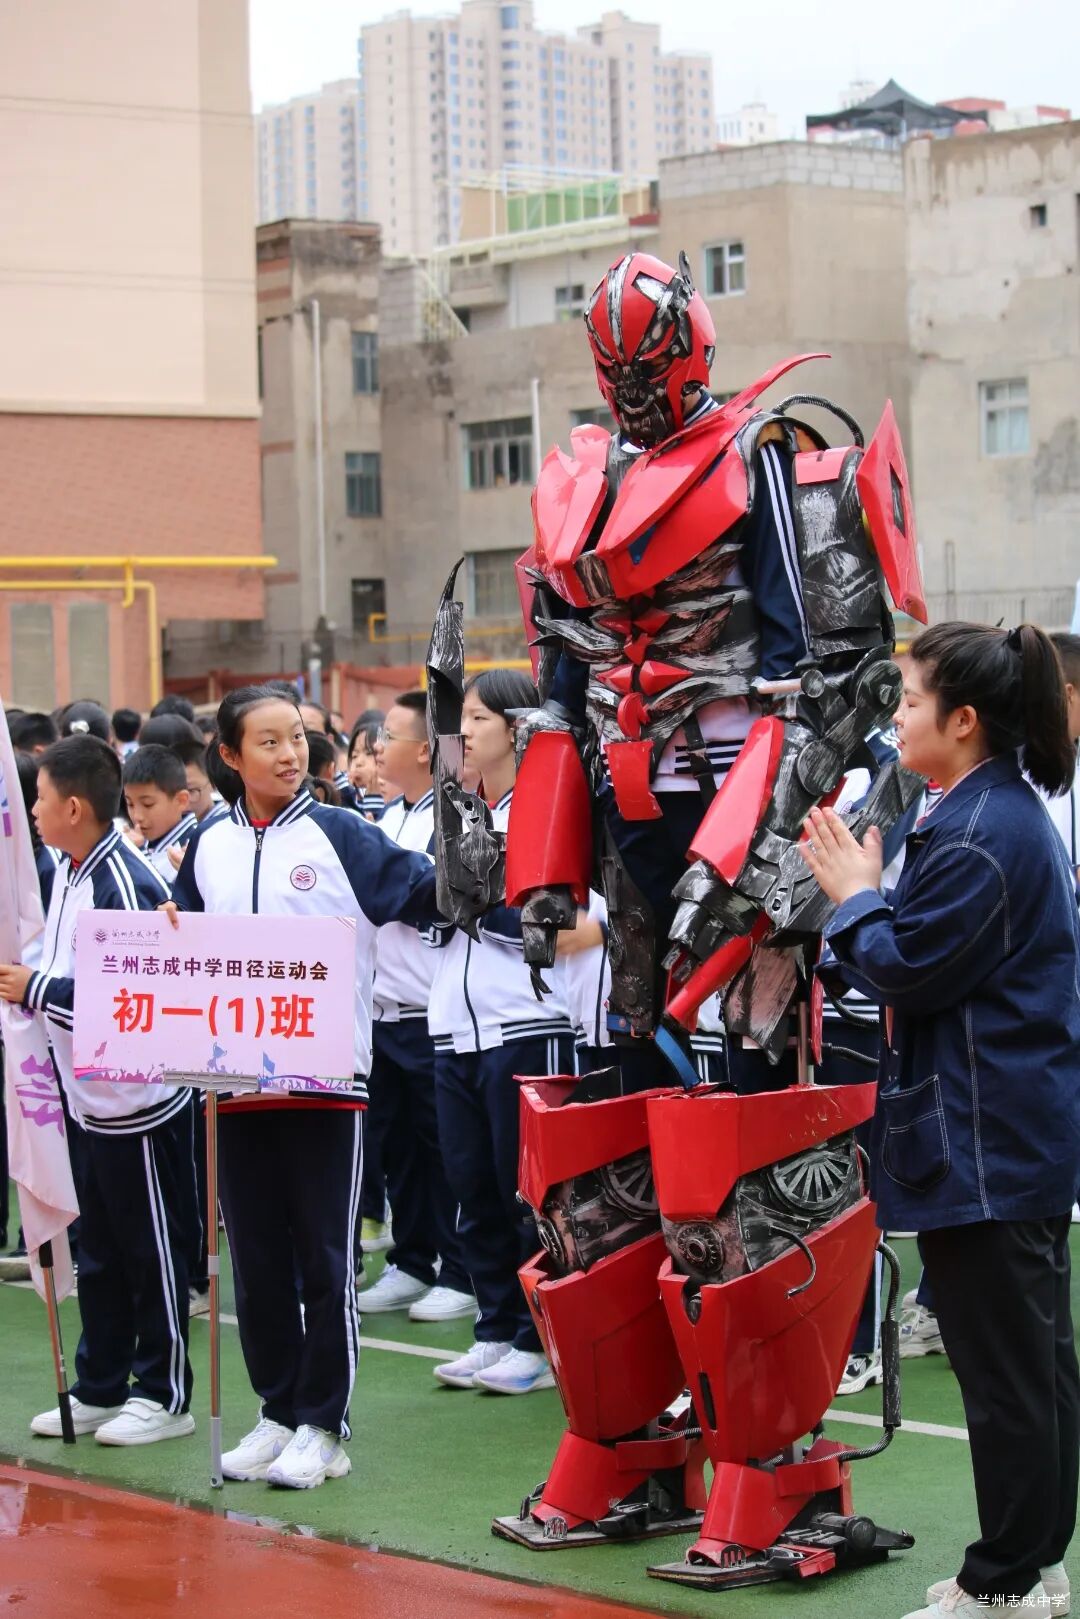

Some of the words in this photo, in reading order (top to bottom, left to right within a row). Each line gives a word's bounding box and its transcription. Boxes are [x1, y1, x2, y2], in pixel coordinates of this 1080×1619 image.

[102, 956, 328, 981] 兰州志成中学田径运动会
[113, 988, 315, 1039] 初一(1)班
